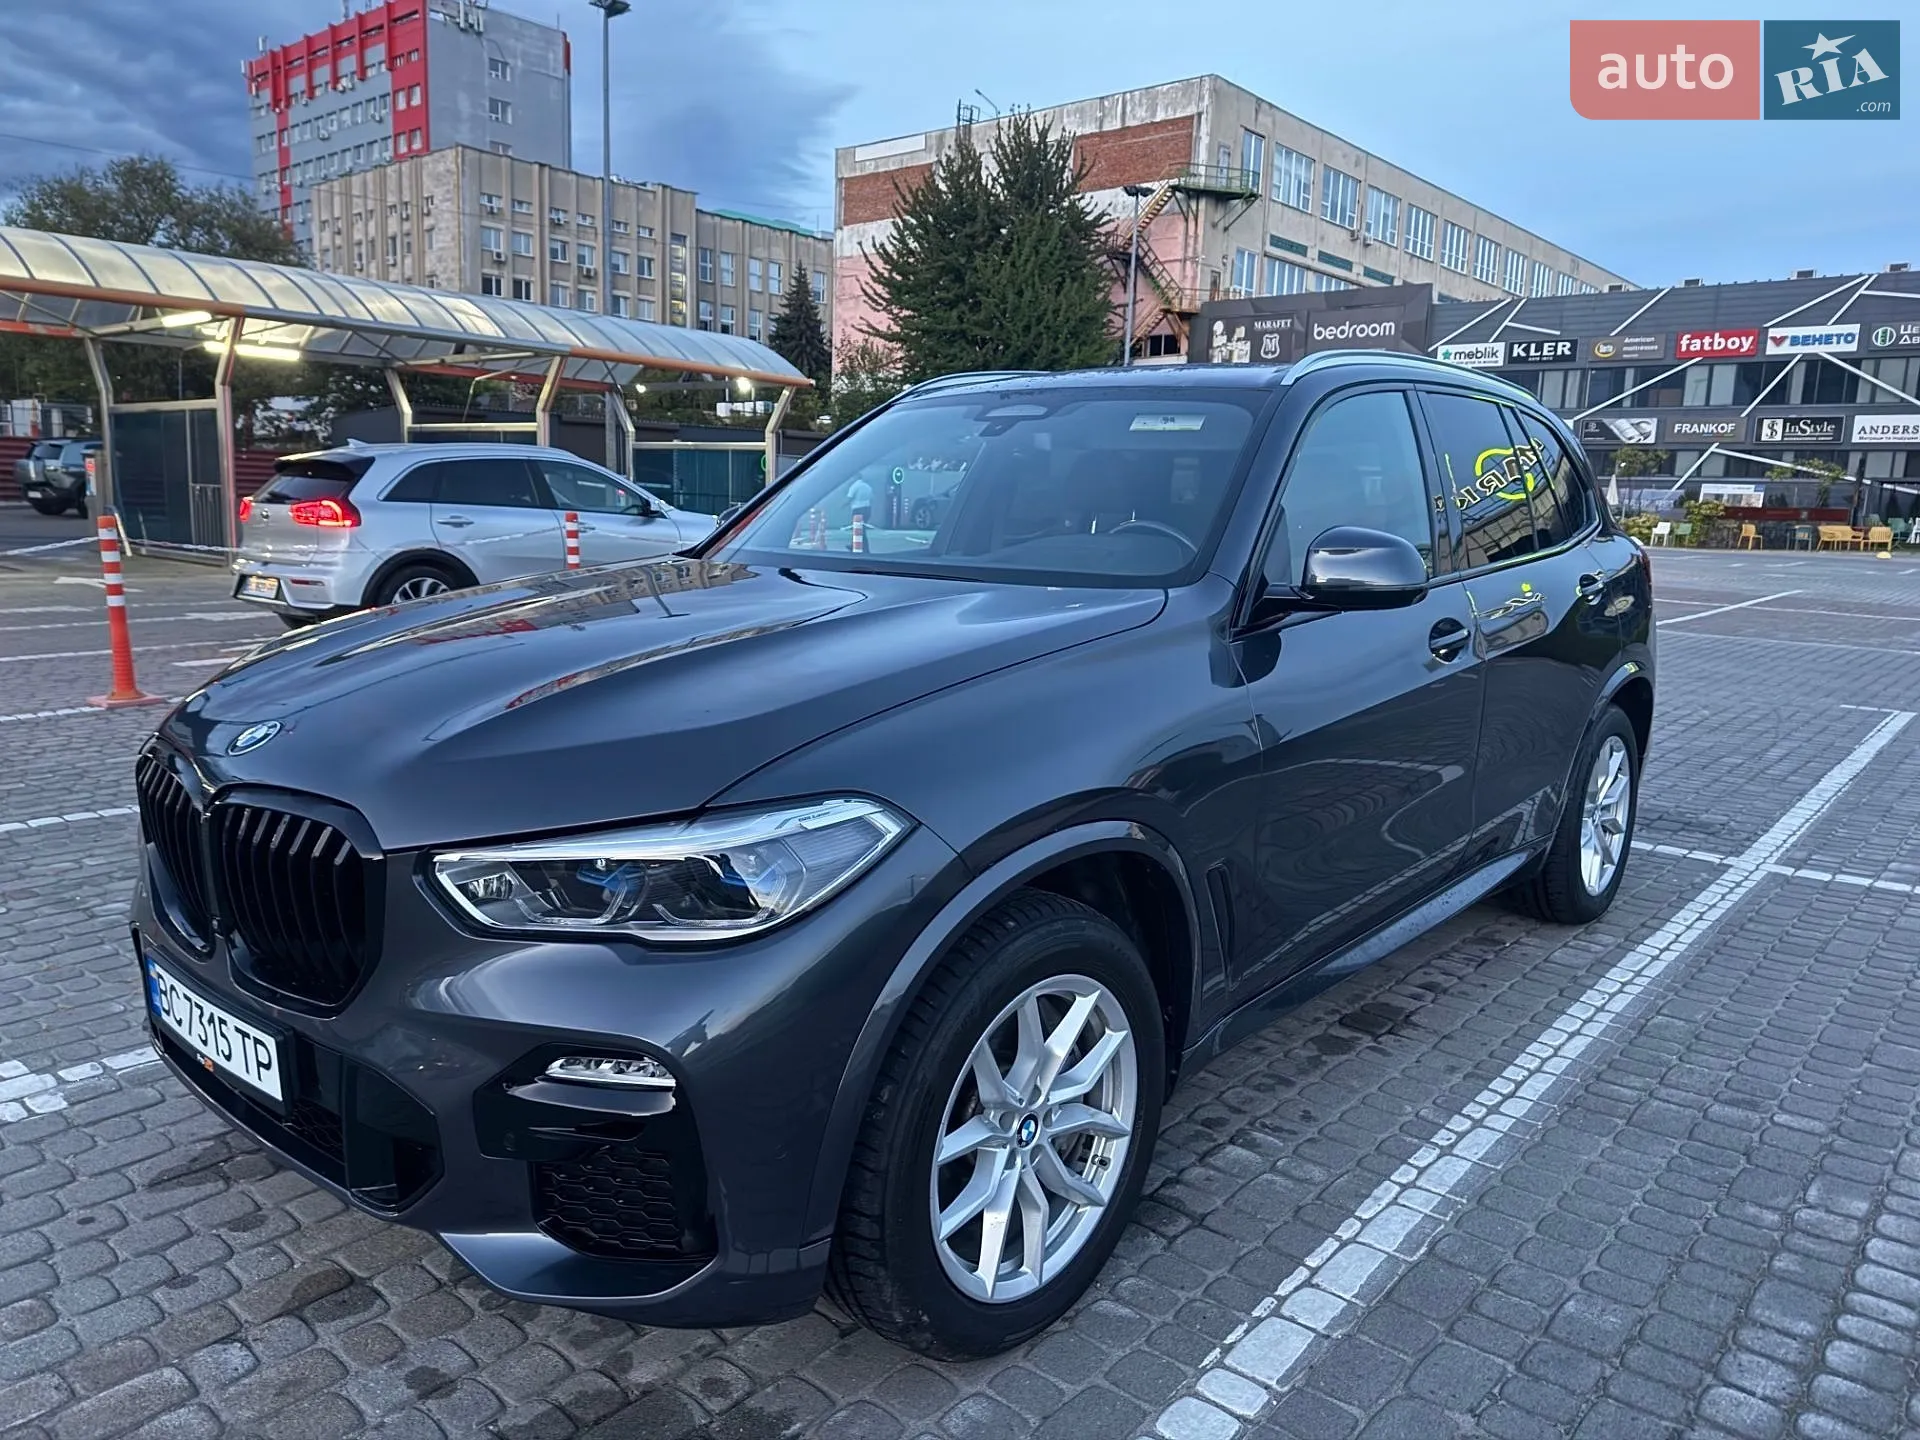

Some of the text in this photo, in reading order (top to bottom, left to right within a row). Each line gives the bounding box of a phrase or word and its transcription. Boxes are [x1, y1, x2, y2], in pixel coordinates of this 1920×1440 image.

[1254, 319, 1292, 329] MARAFET
[1313, 321, 1395, 340] bedroom
[1512, 342, 1571, 357] KLER
[1680, 333, 1753, 352] fatboy
[1454, 347, 1499, 360] meblik
[1674, 423, 1736, 434] FRANKOF
[1785, 419, 1836, 435] InStyle
[1858, 426, 1920, 435] ANDERS
[157, 972, 183, 1027] BC
[234, 1025, 272, 1081] TP
